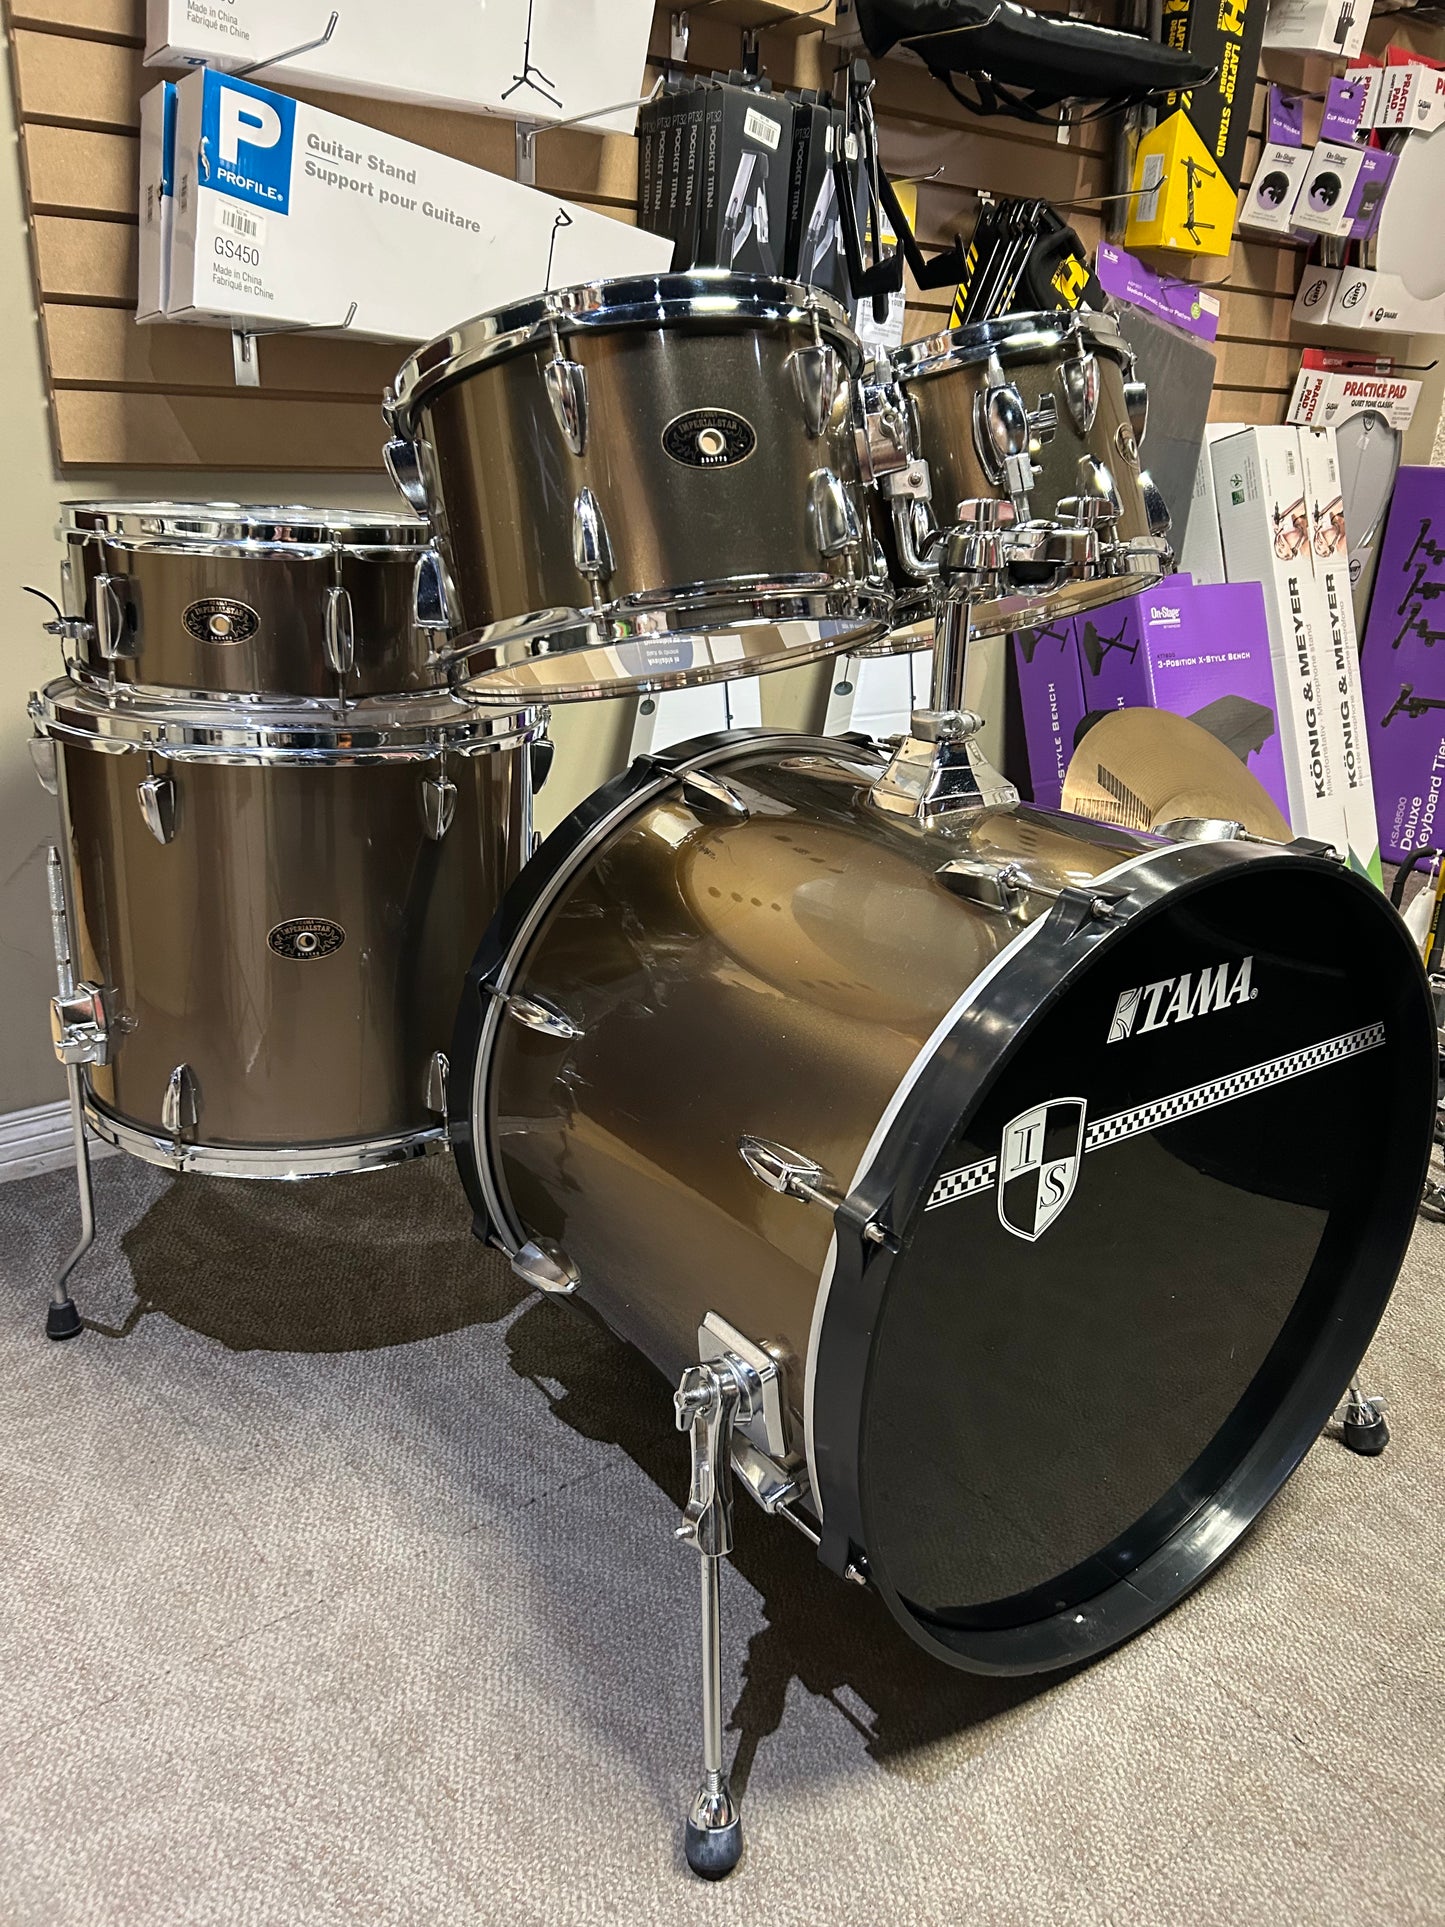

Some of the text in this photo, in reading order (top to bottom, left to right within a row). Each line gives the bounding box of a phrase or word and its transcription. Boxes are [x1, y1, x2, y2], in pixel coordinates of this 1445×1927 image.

[186, 11, 250, 41] Fabriqué en Chine
[187, 0, 238, 26] Made in China
[687, 110, 703, 124] PT32
[706, 110, 722, 124] PT32
[1216, 44, 1241, 157] LAPTOP STAND
[1390, 87, 1401, 110] PAD
[1395, 73, 1413, 124] PRACTICE
[219, 85, 281, 165] P
[307, 133, 417, 185] Guitar Stand
[655, 130, 666, 210] POCKET TITAN
[670, 127, 682, 208] POCKET TITAN
[685, 124, 698, 206] POCKET TITAN
[707, 125, 717, 208] POCKET TITAN
[795, 141, 805, 184] POCKET
[217, 167, 278, 200] PROFILE
[304, 160, 481, 233] Support pour Guitare
[214, 236, 260, 266] GS450
[212, 273, 274, 300] Fabriqué en Chine
[213, 262, 262, 286] Made in China
[1302, 389, 1313, 409] PAD
[1305, 378, 1323, 422] PRACTICE
[1343, 381, 1407, 399] PRACTICE PAD
[1351, 399, 1394, 409] QUIET TONE CLASSIC
[678, 418, 738, 433] IMPERIALSTAR
[194, 606, 244, 616] IMPERIALSTAR
[1150, 606, 1180, 620] On-Stage
[1157, 651, 1251, 669] 3-POSITION X-STYLE BENCH
[1325, 573, 1358, 789] KÖNIG & MEYER
[1048, 683, 1060, 732] BENCH
[1288, 577, 1326, 799] KÖNIG & MEYER
[1306, 623, 1334, 796] Mikrofonstativ Microphone stand
[1389, 796, 1408, 848] KSA8500
[1400, 796, 1423, 851] Deluxe
[280, 925, 331, 935] IMPERIALSTAR
[1136, 955, 1254, 1035] TAMA
[1038, 1162, 1067, 1209] S
